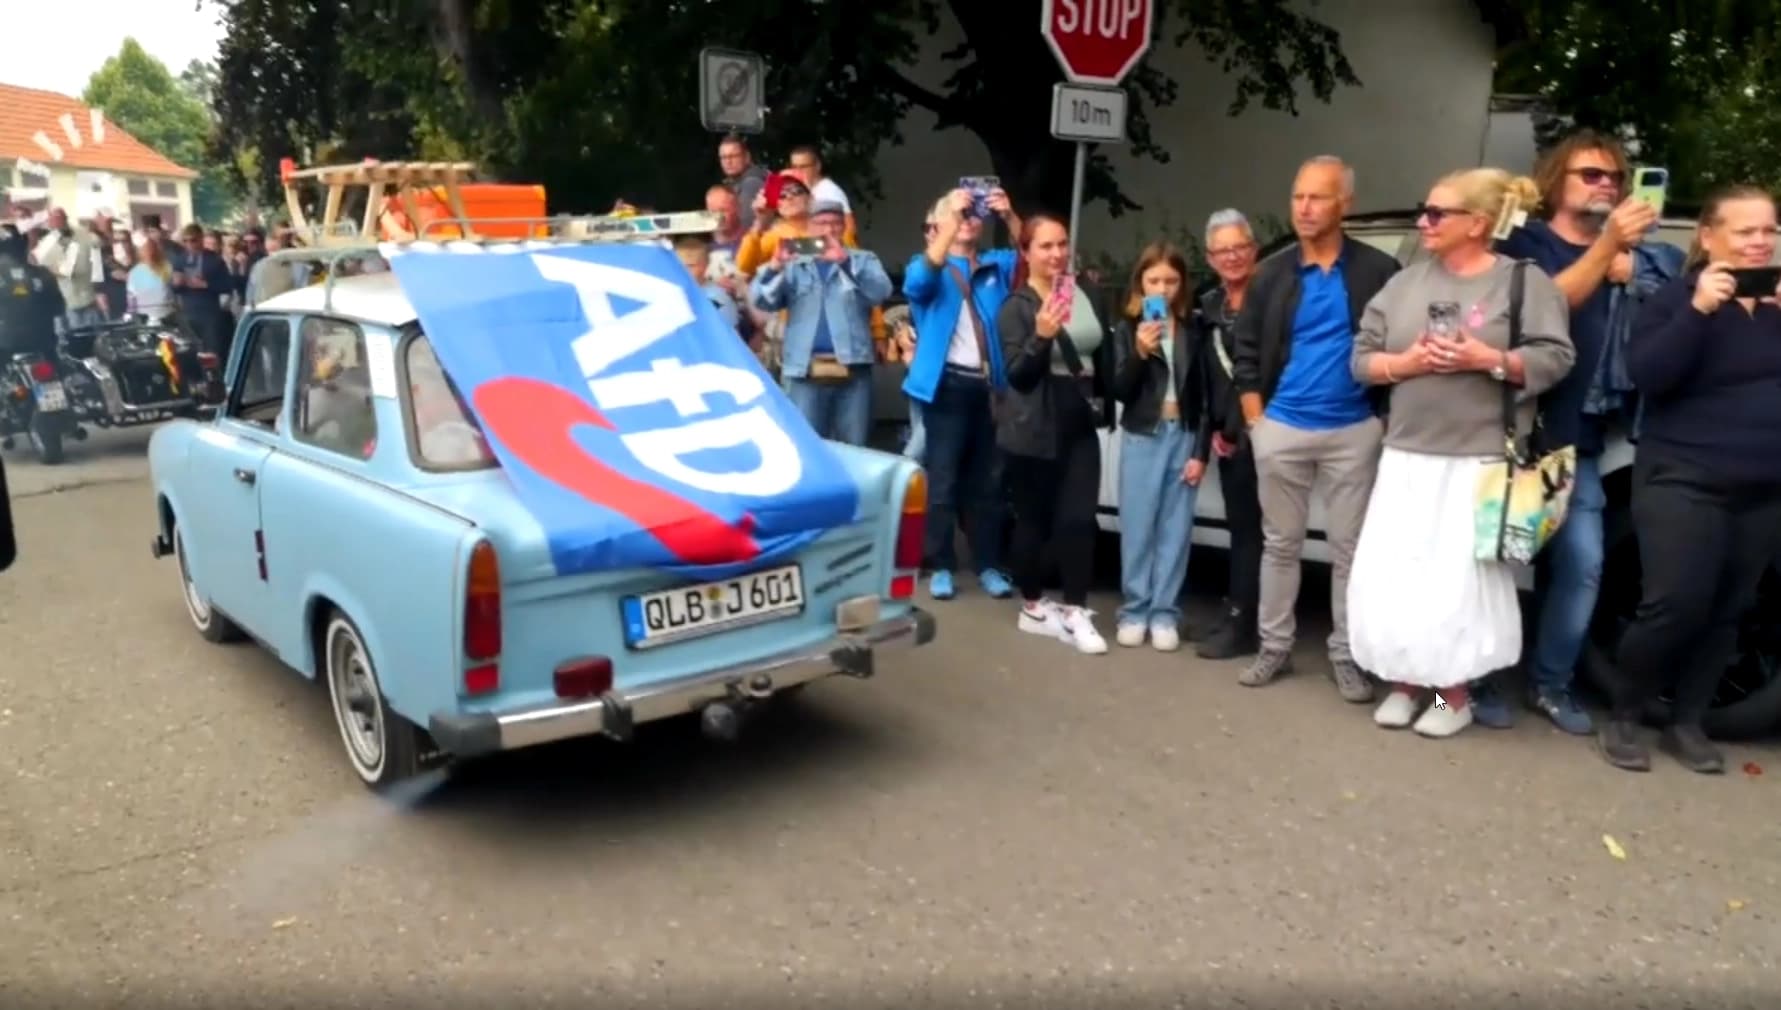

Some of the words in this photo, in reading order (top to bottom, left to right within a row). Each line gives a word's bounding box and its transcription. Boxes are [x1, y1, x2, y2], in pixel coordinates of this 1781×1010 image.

[1057, 0, 1142, 39] STOP
[530, 253, 802, 496] AfD
[645, 590, 705, 631] QLB
[726, 582, 743, 614] J
[750, 571, 798, 609] 601
